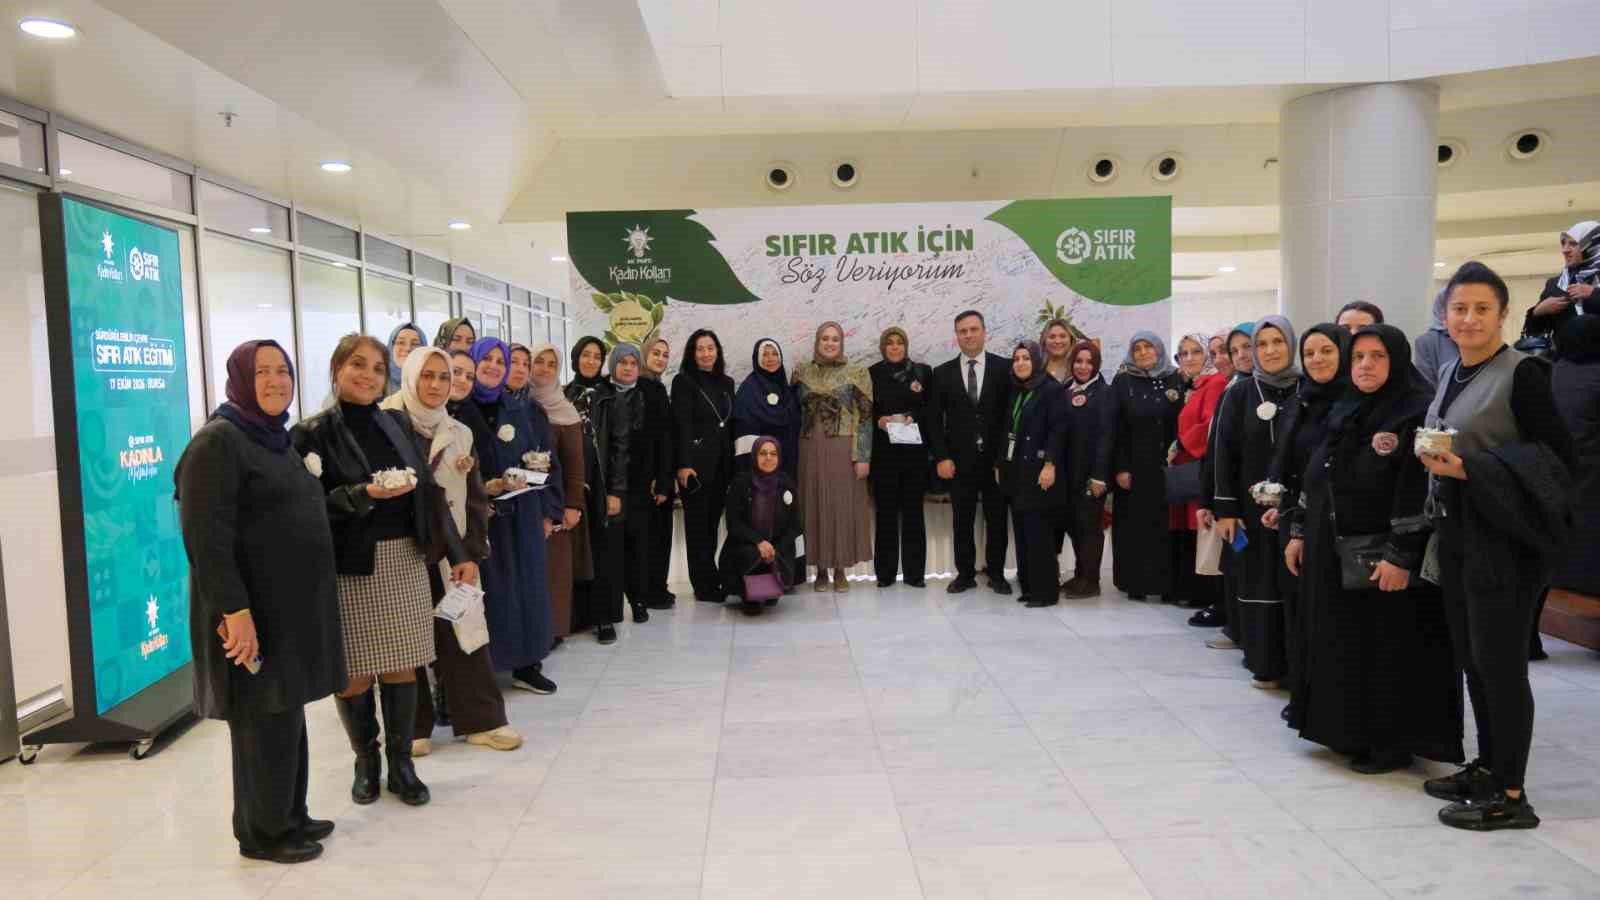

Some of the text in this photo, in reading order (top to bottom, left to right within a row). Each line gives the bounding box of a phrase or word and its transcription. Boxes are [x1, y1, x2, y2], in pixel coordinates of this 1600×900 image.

[765, 224, 974, 258] SIFIR ATIK İÇİN
[1093, 229, 1136, 244] SIFIR
[1094, 245, 1136, 261] ATIK
[609, 266, 671, 285] Kadın Kolları
[781, 256, 827, 293] Söz
[836, 255, 965, 290] Veriyorum
[123, 346, 142, 365] ATIK
